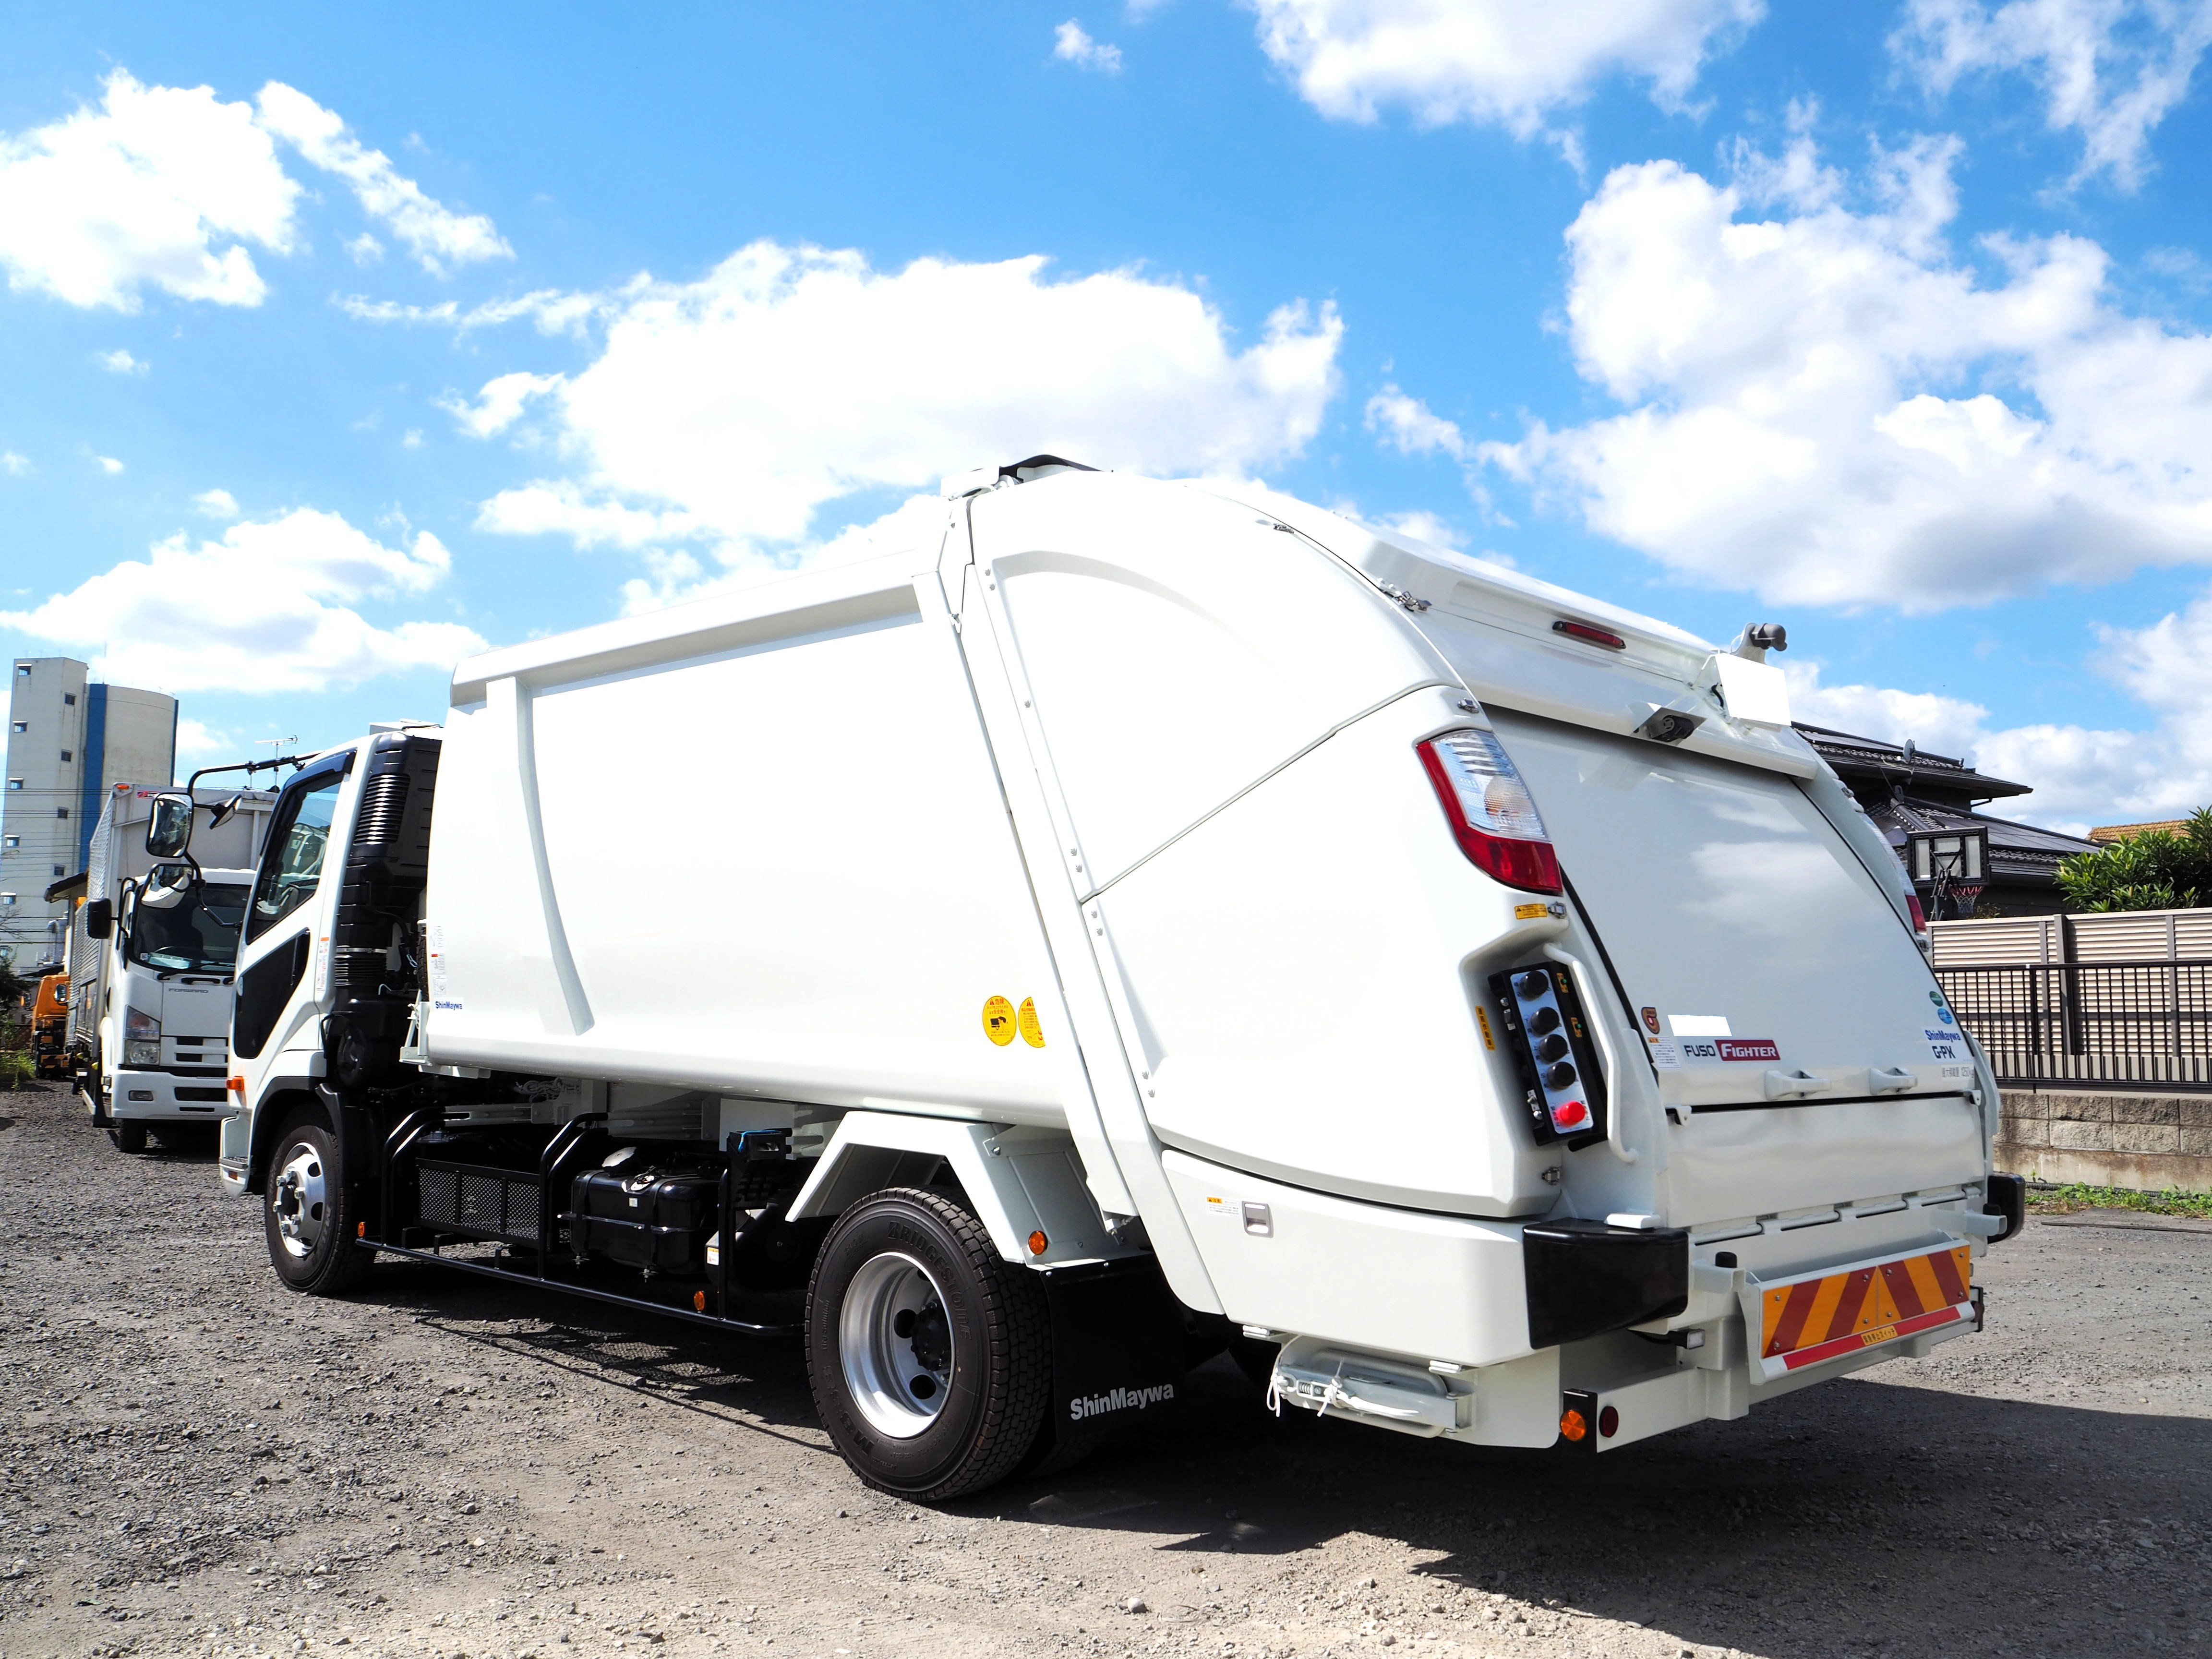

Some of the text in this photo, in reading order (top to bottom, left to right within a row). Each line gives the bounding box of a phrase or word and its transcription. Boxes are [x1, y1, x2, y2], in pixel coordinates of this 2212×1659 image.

[435, 1001, 463, 1010] ShinMaywa
[1925, 1030, 1961, 1043] ShinMaywa
[1683, 1045, 1716, 1057] FUSO
[1721, 1043, 1776, 1057] FIGHTER
[1932, 1046, 1956, 1059] G-PX
[1070, 1383, 1174, 1420] ShinMaywa
